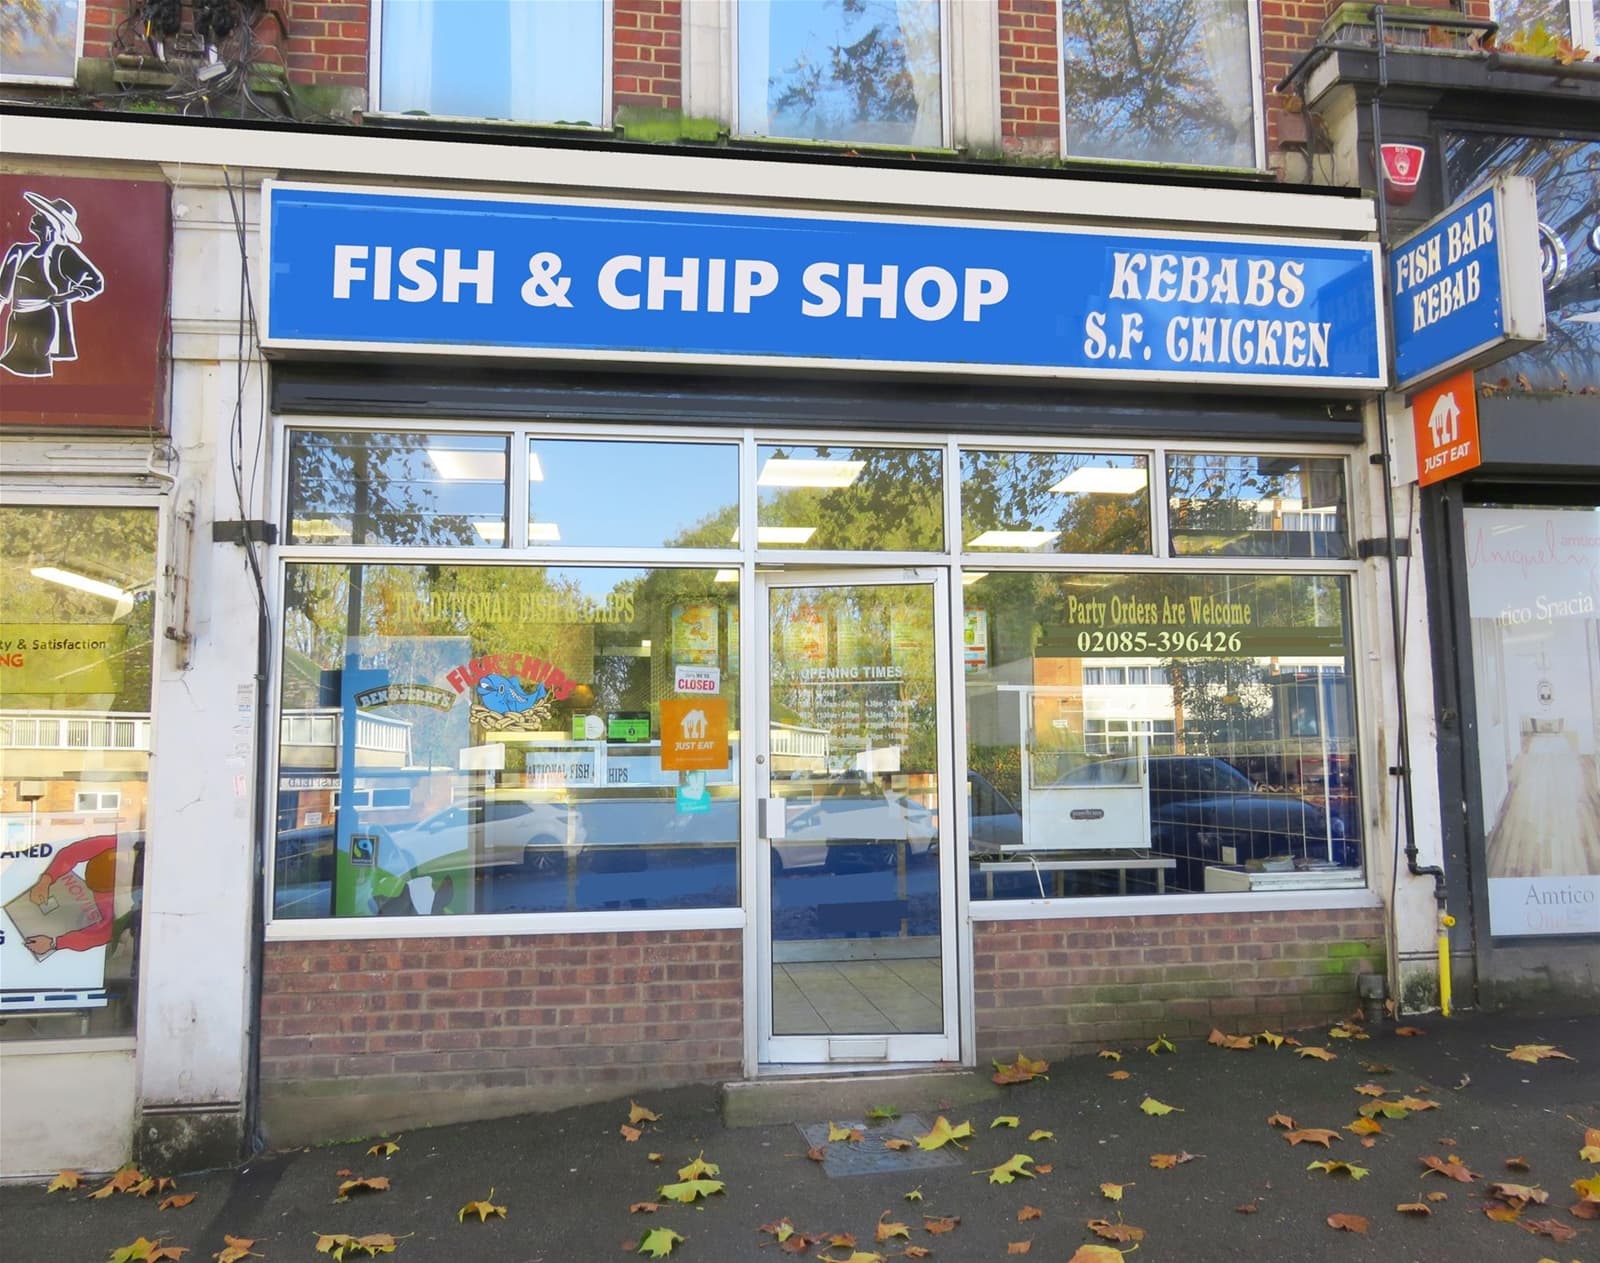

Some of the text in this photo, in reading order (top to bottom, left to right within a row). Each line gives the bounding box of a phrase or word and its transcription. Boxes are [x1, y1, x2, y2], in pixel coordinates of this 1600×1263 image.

[1396, 201, 1494, 296] FISH BAR
[333, 244, 1010, 322] FISH & CHIP SHOP
[1109, 252, 1305, 309] KEBABS
[1413, 260, 1481, 333] KEBAB
[1084, 311, 1332, 368] S.F. CHICKEN
[1424, 441, 1471, 475] JUST EAT
[393, 591, 512, 623] TRADITIONAL
[520, 592, 562, 624] FISH
[1067, 595, 1252, 628] Party Orders Are Welcome
[1536, 592, 1594, 624] Spacia
[16, 638, 27, 650] &
[32, 638, 107, 650] Satisfaction
[1077, 631, 1242, 652] 02085-396426
[0, 652, 24, 668] NG
[800, 666, 903, 679] OPENING TIMES
[678, 678, 715, 691] CLOSED
[675, 741, 715, 751] JUST EAT
[570, 764, 590, 779] FISH
[608, 768, 629, 783] HIPS
[1524, 883, 1595, 905] Amtico
